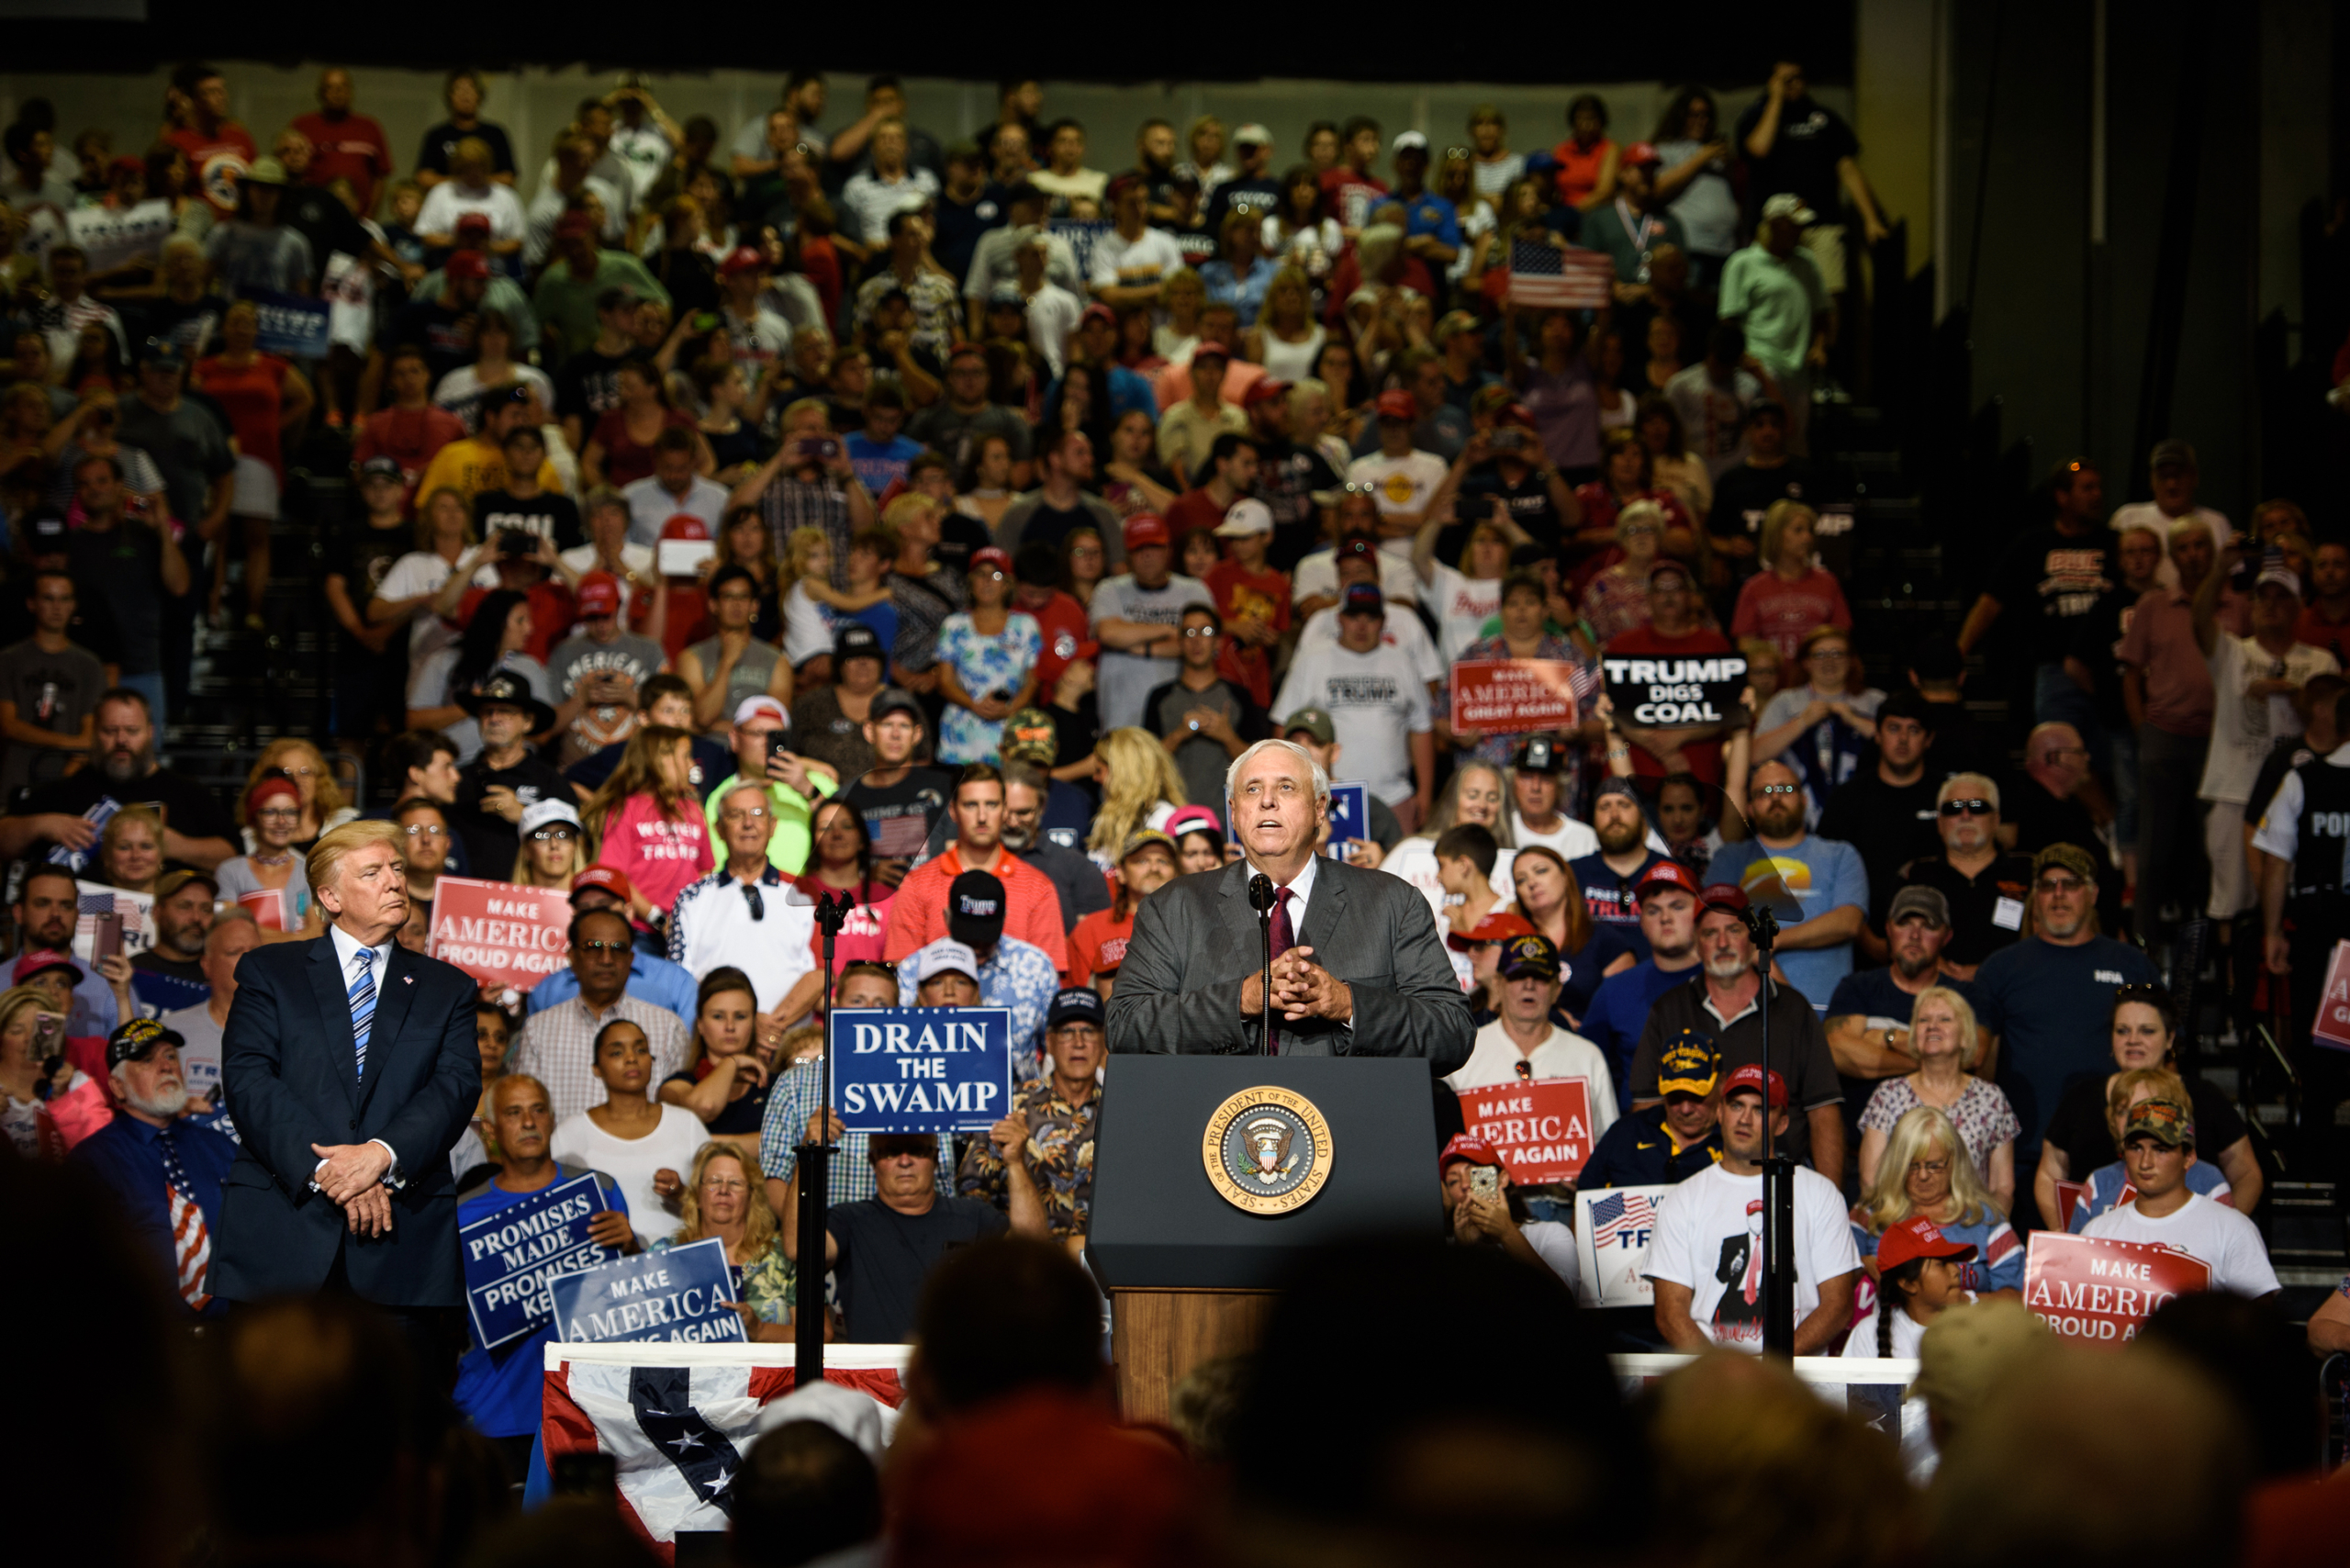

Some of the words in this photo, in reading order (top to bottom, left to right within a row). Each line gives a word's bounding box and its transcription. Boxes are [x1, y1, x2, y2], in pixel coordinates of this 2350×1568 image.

[1603, 658, 1747, 685] TRUMP
[1649, 684, 1704, 702] DIGS
[1633, 701, 1722, 723] COAL
[636, 820, 701, 840] WOMEN
[642, 844, 700, 861] TRUMP
[487, 898, 541, 920] MAKE
[959, 894, 998, 912] Trump
[435, 914, 573, 953] AMERIC
[837, 921, 881, 936] UMP
[436, 943, 510, 969] PROUD
[2094, 969, 2124, 984] NRA
[852, 1022, 990, 1054] DRAIN
[896, 1058, 946, 1079] THE
[844, 1081, 999, 1114] SWAMP
[1268, 1092, 1281, 1101] OF
[1282, 1095, 1299, 1108] THE
[1478, 1097, 1533, 1119] MAKE
[1208, 1091, 1264, 1148] PRESIDENT
[1301, 1106, 1328, 1159] UNITED
[1209, 1151, 1219, 1170] THE
[1512, 1144, 1579, 1165] AGAIN
[1214, 1171, 1225, 1182] OF
[1280, 1169, 1323, 1208] STATES
[1225, 1182, 1258, 1208] SEAL
[467, 1193, 593, 1262] PROMISES
[501, 1225, 576, 1273] MADE
[484, 1242, 607, 1312] PROMISES
[2091, 1259, 2152, 1282] MAKE
[610, 1269, 671, 1299] MAKE
[521, 1291, 552, 1322] KE
[569, 1282, 729, 1343] AMERICA
[670, 1315, 739, 1343] AGAIN
